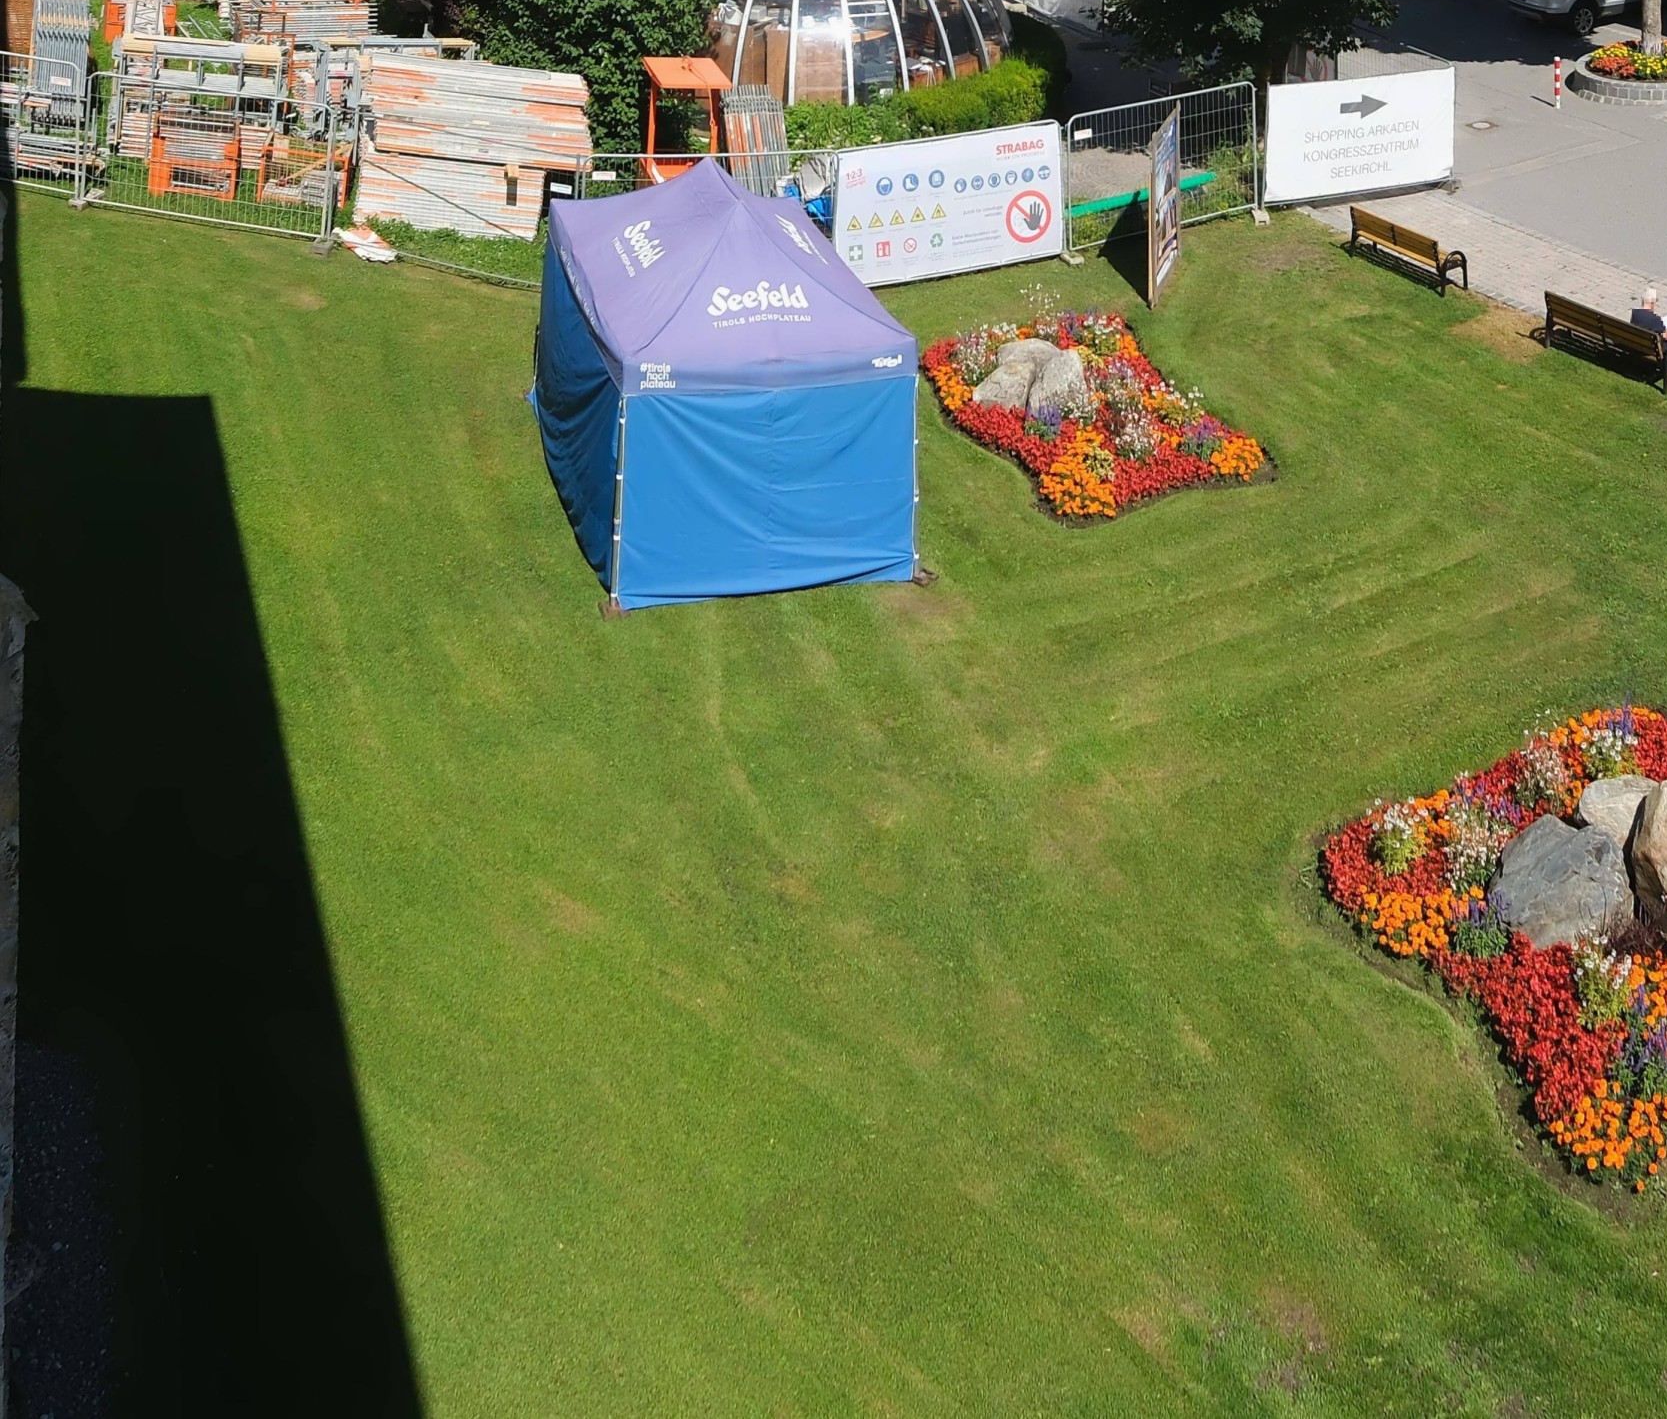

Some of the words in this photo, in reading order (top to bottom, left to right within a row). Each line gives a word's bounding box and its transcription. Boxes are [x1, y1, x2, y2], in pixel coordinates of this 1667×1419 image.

[1303, 126, 1365, 144] SHOPPING
[1367, 120, 1420, 137] ARKADEN
[995, 139, 1045, 156] STRABAG
[1303, 138, 1419, 162] KONGRESSZENTRUM
[1330, 161, 1392, 179] SEEKIRCHL
[707, 280, 810, 317] Seefeld
[713, 317, 746, 329] TIROLS
[748, 313, 812, 325] HOCHPLATEAU
[639, 362, 672, 374] #tirols
[645, 370, 670, 381] hoch
[639, 378, 677, 390] plateau
